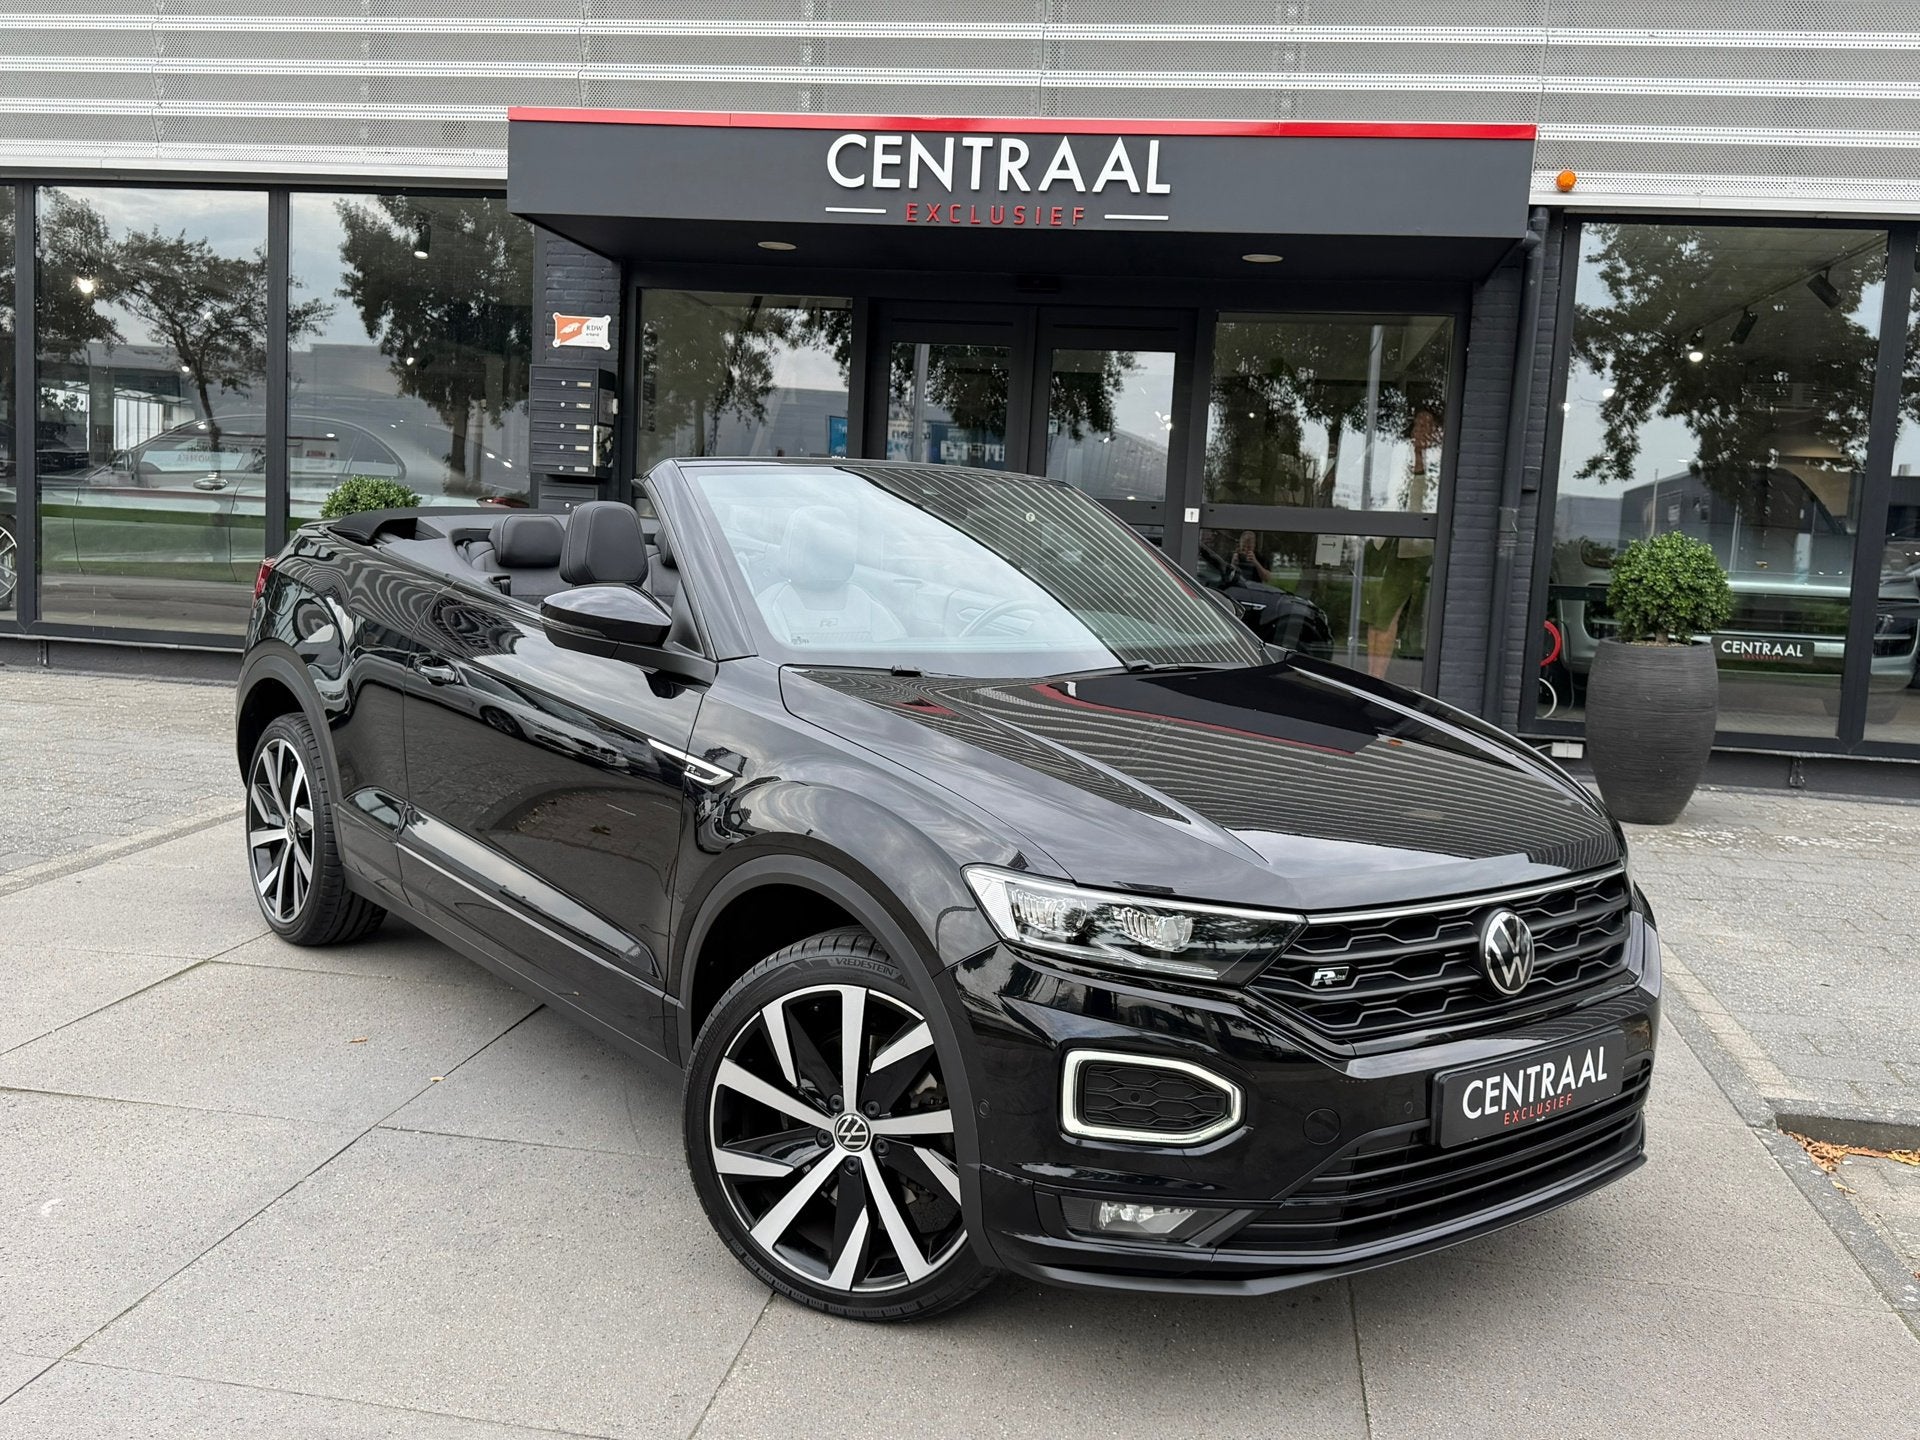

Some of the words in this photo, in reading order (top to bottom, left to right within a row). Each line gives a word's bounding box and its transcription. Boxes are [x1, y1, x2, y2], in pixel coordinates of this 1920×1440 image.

[827, 133, 1171, 194] CENTRAAL
[905, 203, 1087, 226] EXCLUSIEF
[586, 324, 604, 332] RDW
[1721, 640, 1803, 657] CENTRAAL
[835, 957, 895, 977] VREDESTEIN
[1462, 1046, 1608, 1120] CENTRAAL
[1504, 1093, 1573, 1126] EXCLUSIEF
